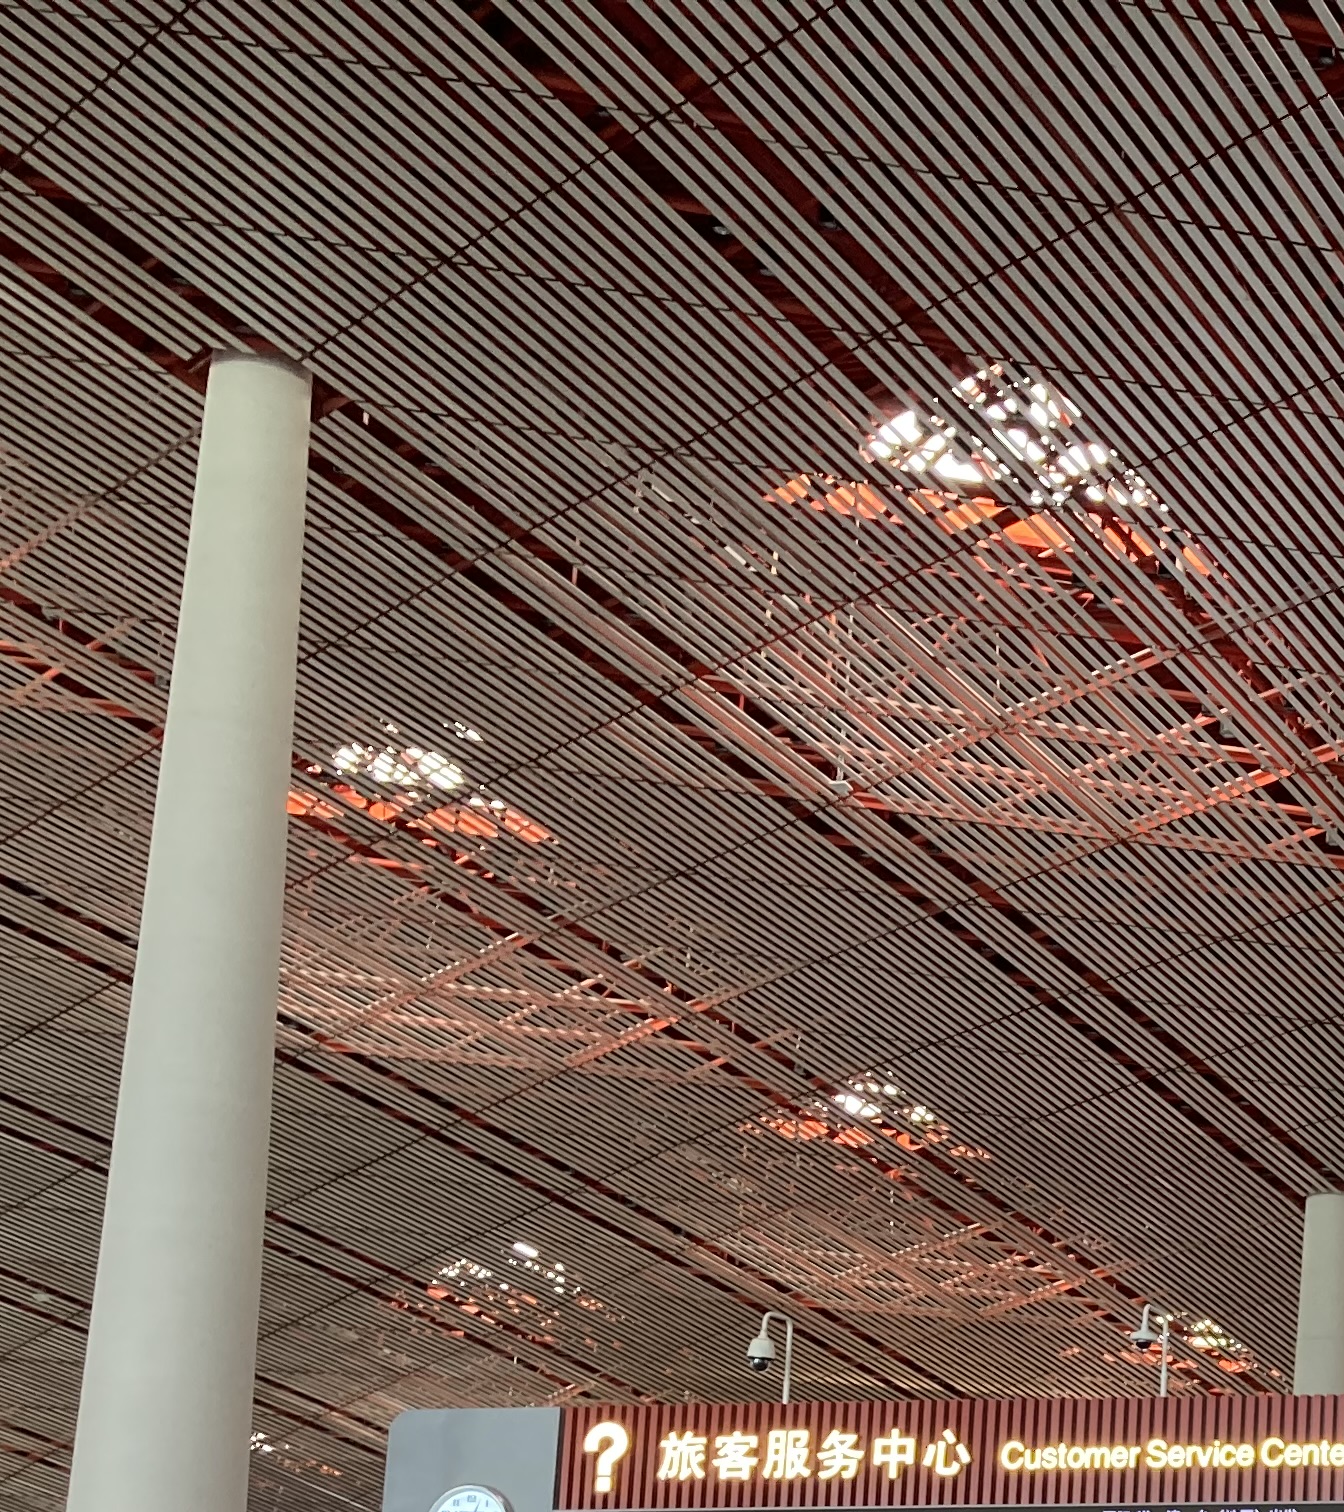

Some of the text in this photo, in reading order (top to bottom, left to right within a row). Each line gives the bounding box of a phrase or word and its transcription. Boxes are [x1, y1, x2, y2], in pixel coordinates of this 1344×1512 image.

[656, 1429, 972, 1482] 旅客服务中心
[1001, 1440, 1139, 1473] Customer
[1146, 1438, 1255, 1470] Service
